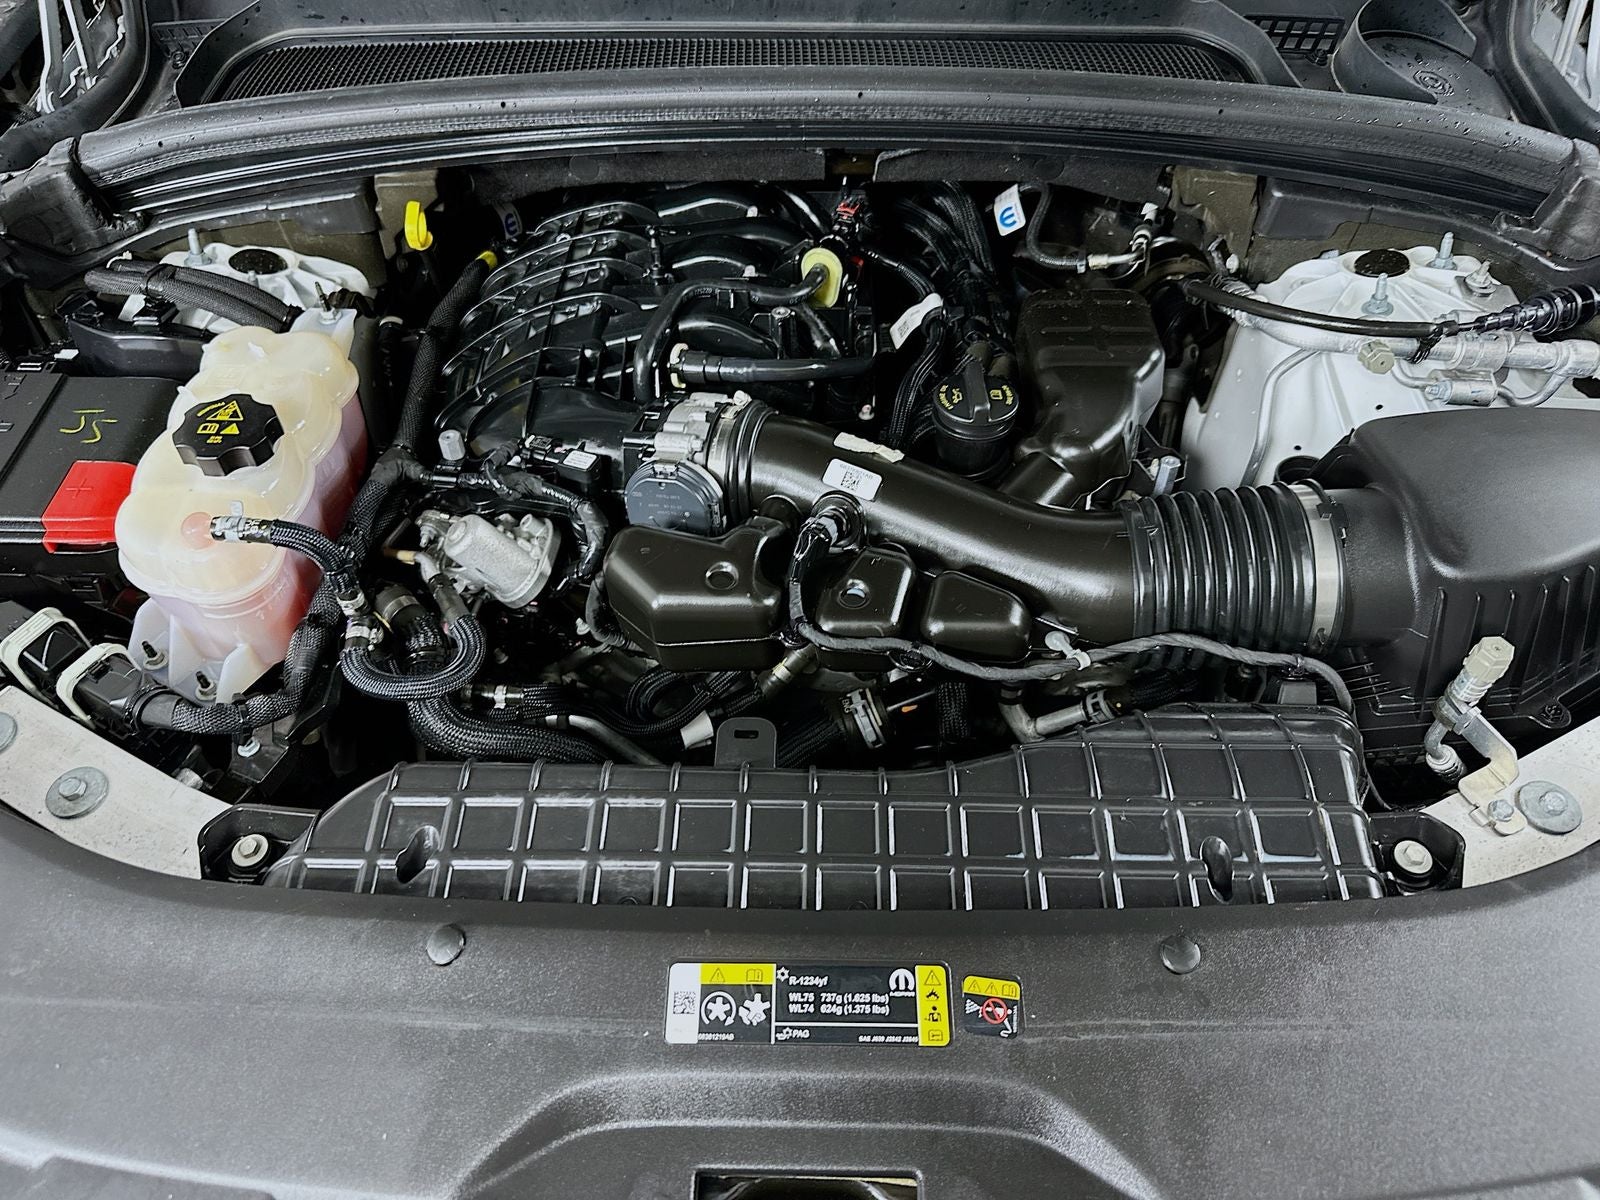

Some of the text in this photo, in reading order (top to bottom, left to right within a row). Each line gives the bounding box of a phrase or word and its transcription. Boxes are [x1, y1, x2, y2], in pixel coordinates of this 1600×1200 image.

[788, 992, 890, 1005] WL75 737g (1.625 lbs)
[788, 1003, 890, 1016] WL74 624g (1.375 lbs)
[792, 1029, 810, 1039] PAG
